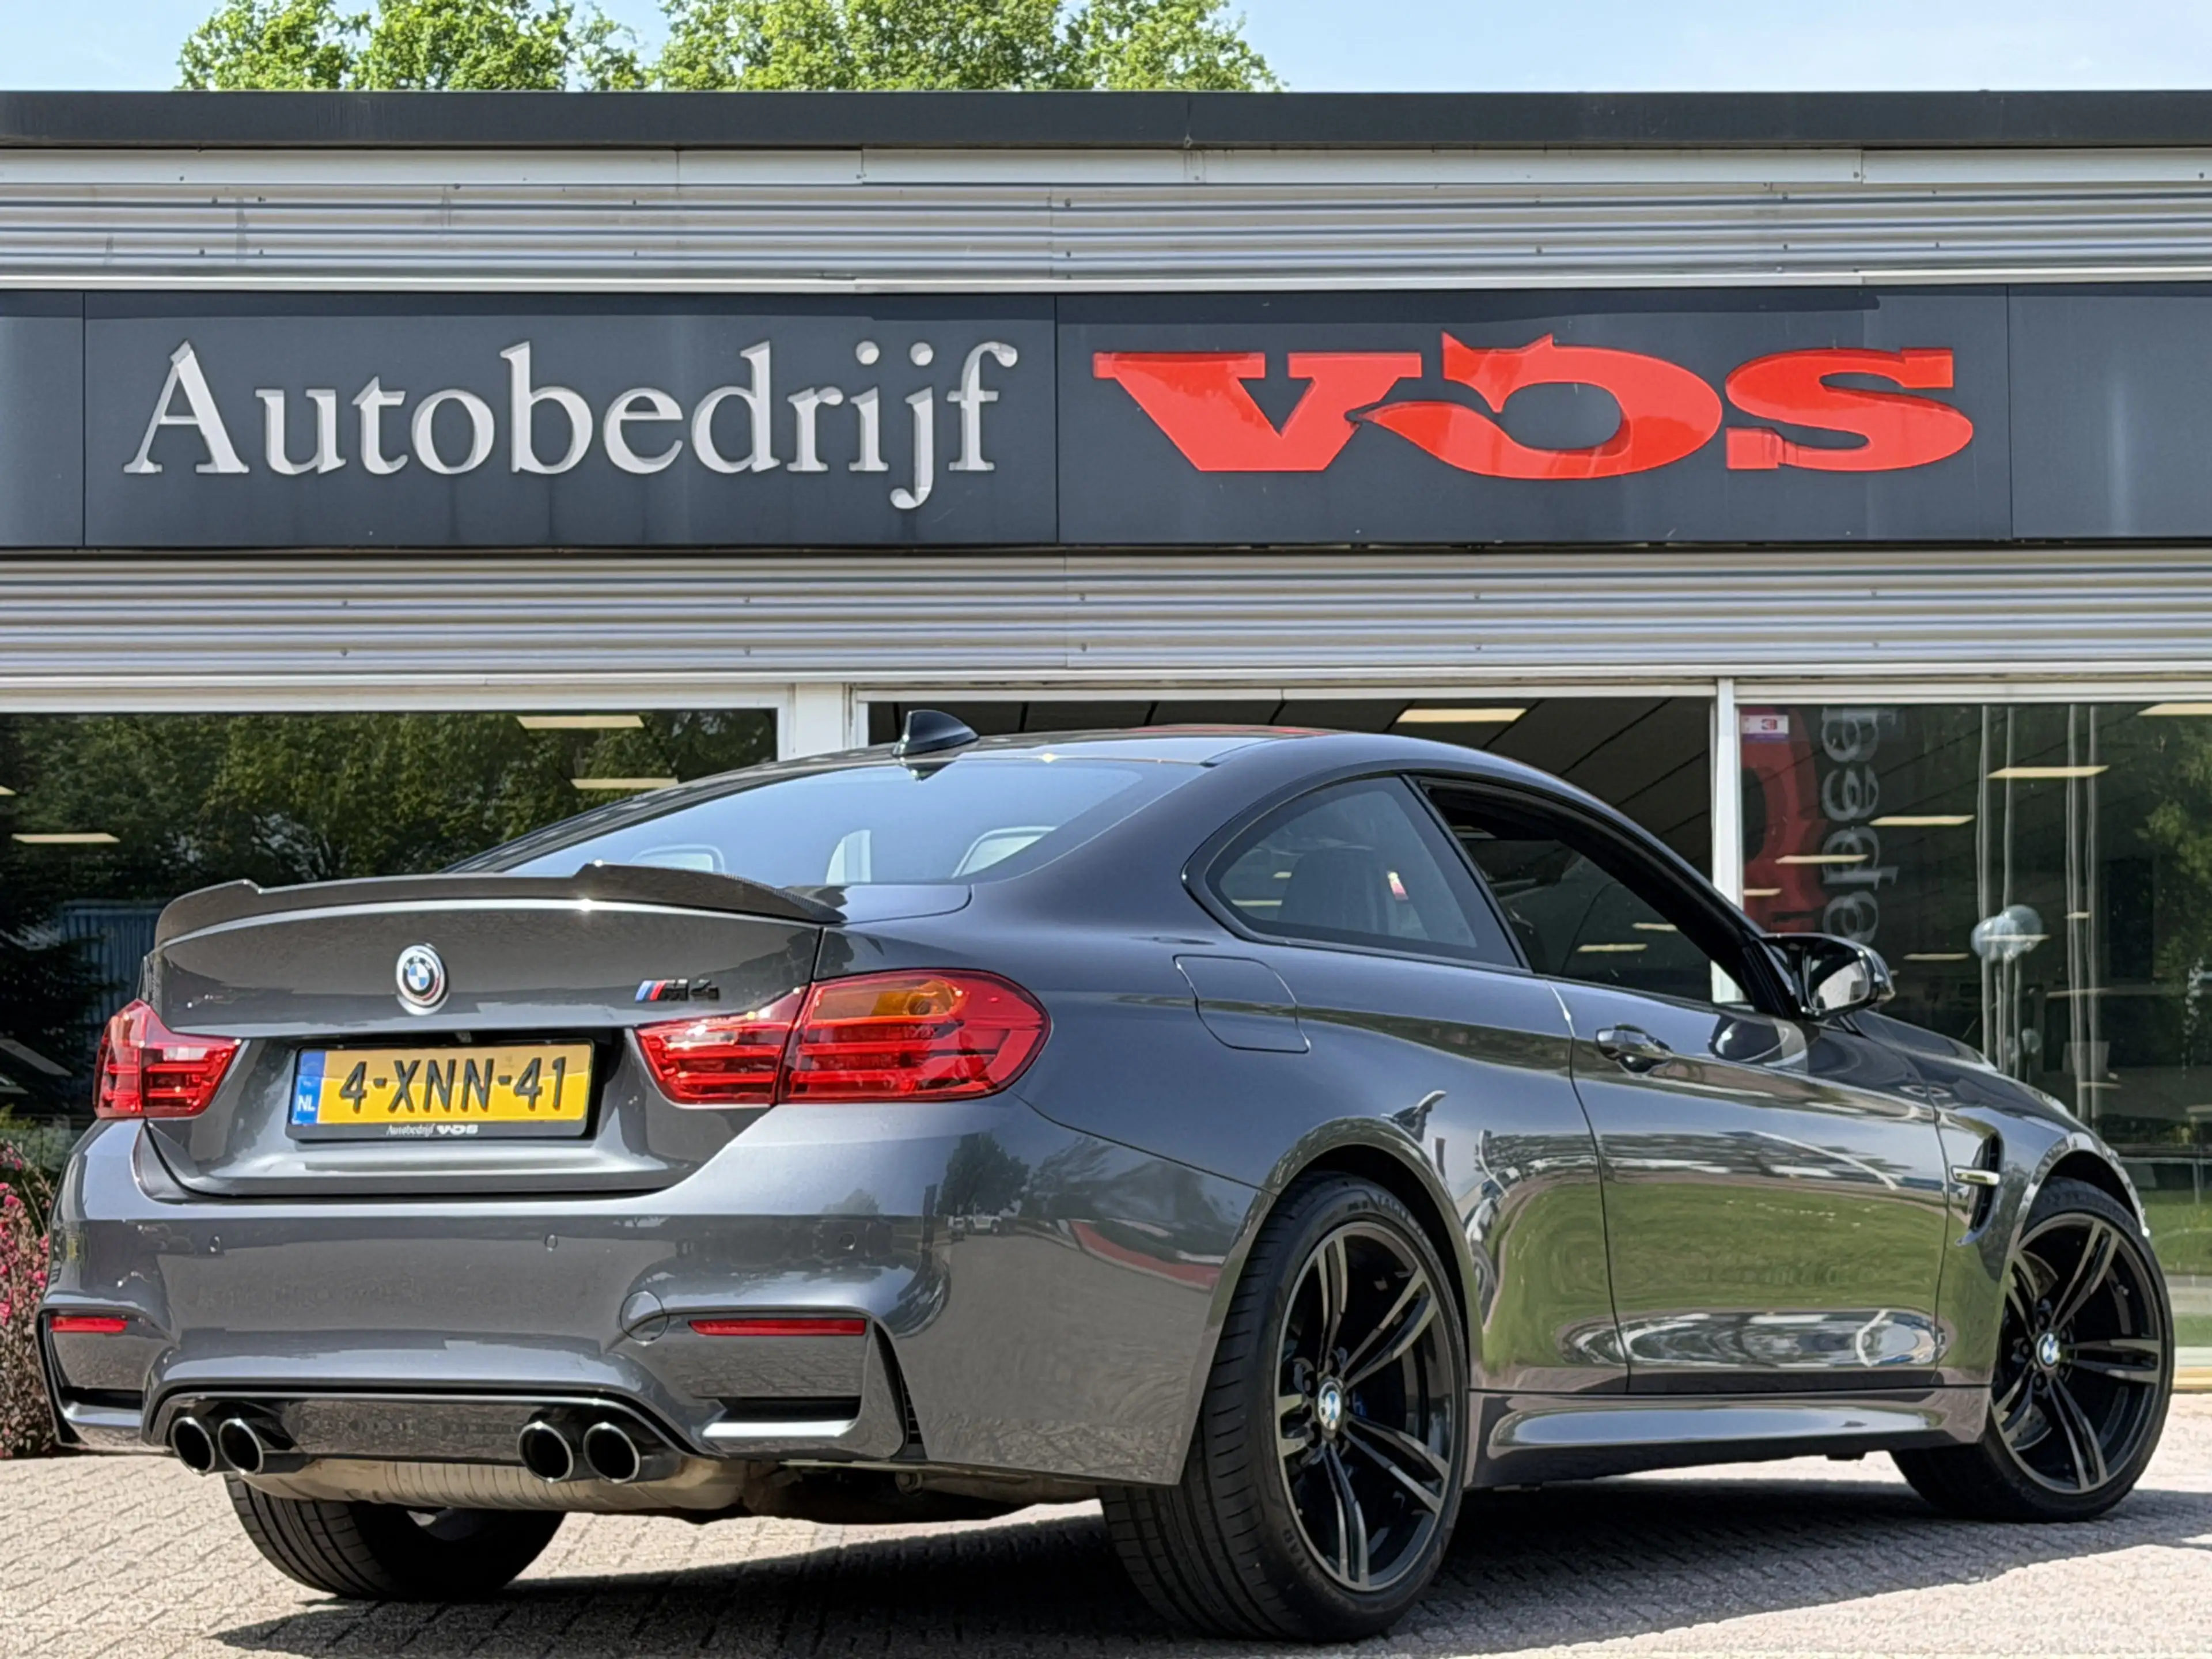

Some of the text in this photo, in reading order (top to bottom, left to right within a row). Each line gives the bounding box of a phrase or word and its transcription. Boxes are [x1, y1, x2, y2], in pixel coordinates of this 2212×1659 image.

[124, 341, 1018, 509] Autobedrijf
[657, 979, 719, 1002] M4
[297, 1094, 316, 1112] NL
[339, 1056, 566, 1114] 4-XNN-41
